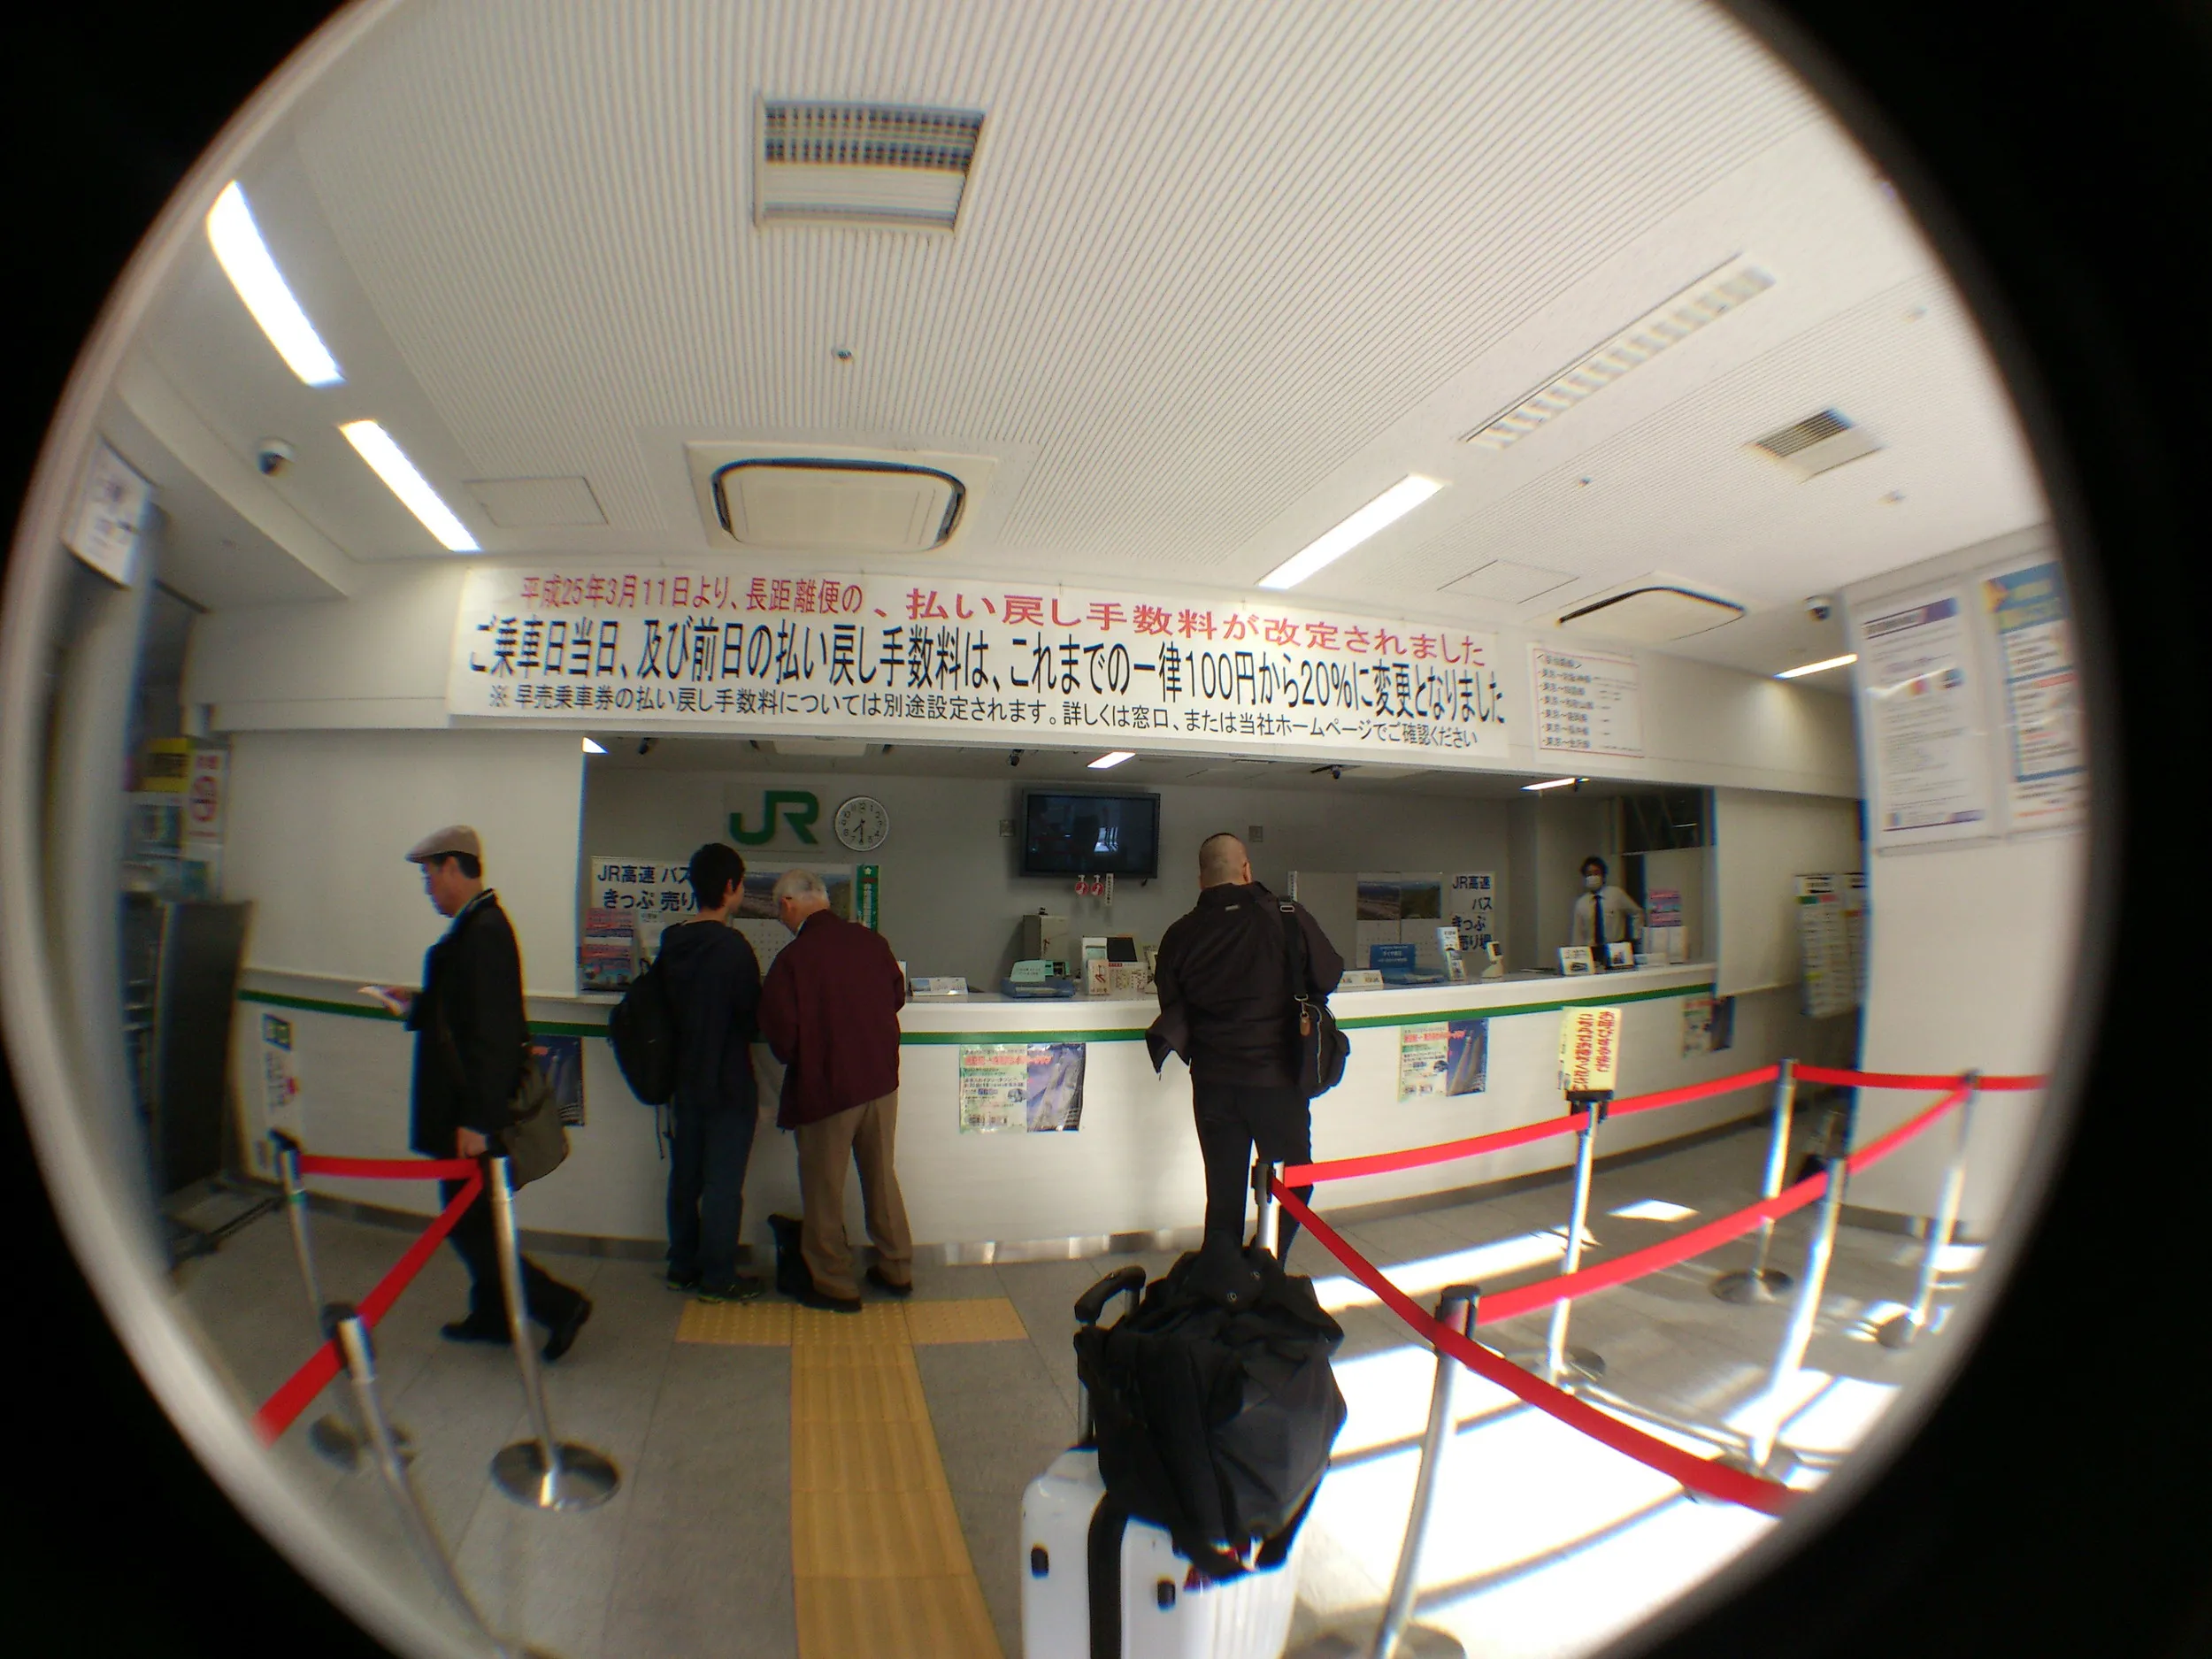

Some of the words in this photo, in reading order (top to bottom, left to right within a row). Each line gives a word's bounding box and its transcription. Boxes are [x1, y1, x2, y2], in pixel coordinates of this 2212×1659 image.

[729, 790, 819, 846] JR
[1452, 875, 1491, 890] JR高速
[1471, 896, 1494, 910] バス
